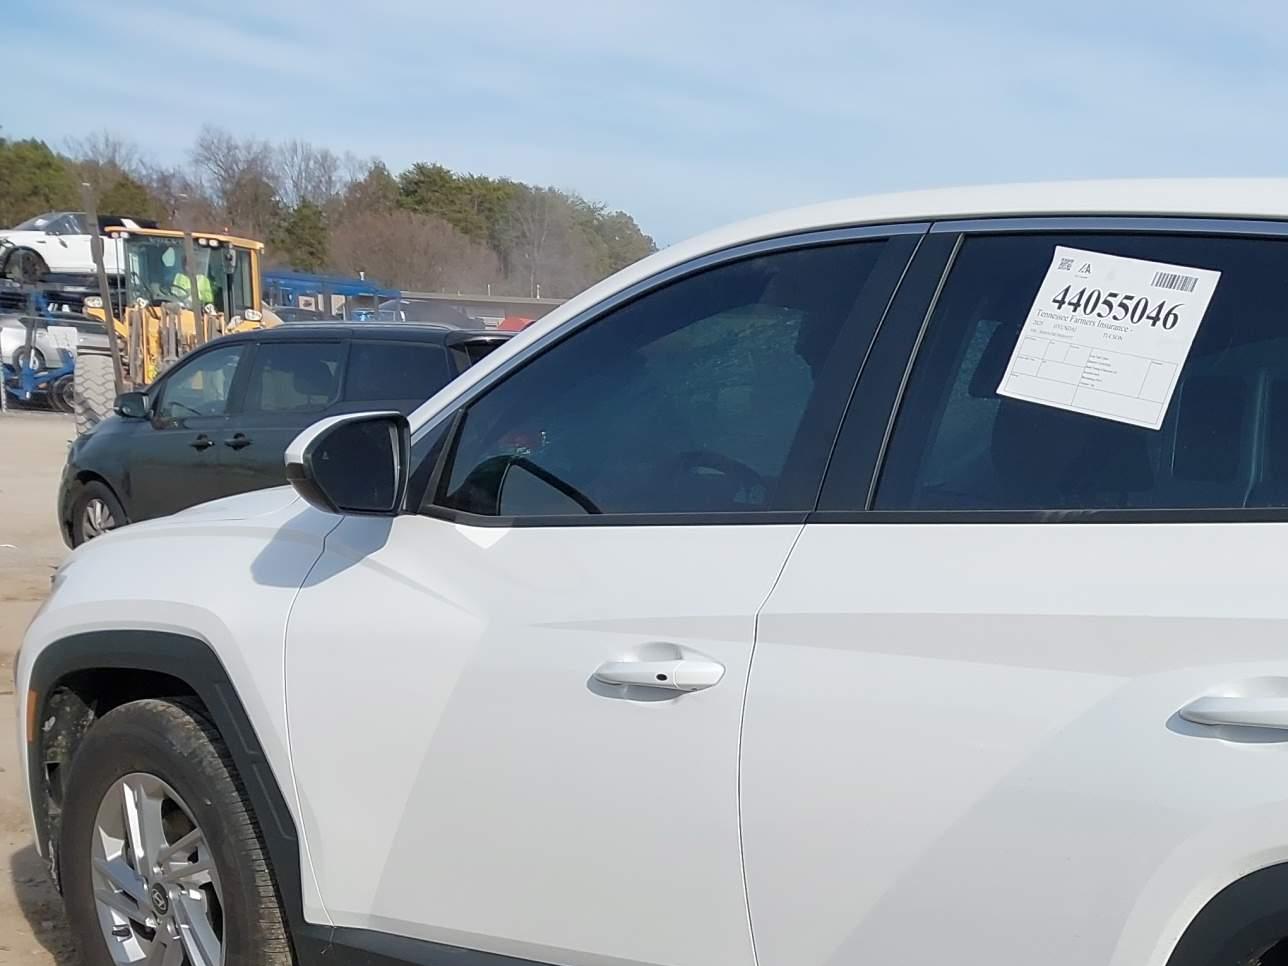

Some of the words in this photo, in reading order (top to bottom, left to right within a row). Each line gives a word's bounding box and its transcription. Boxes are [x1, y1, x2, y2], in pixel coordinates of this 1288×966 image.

[1036, 309, 1069, 322] Tennessee
[1069, 315, 1096, 328] Farmers
[1097, 319, 1129, 333] Insurance
[1052, 284, 1184, 330] 44055046
